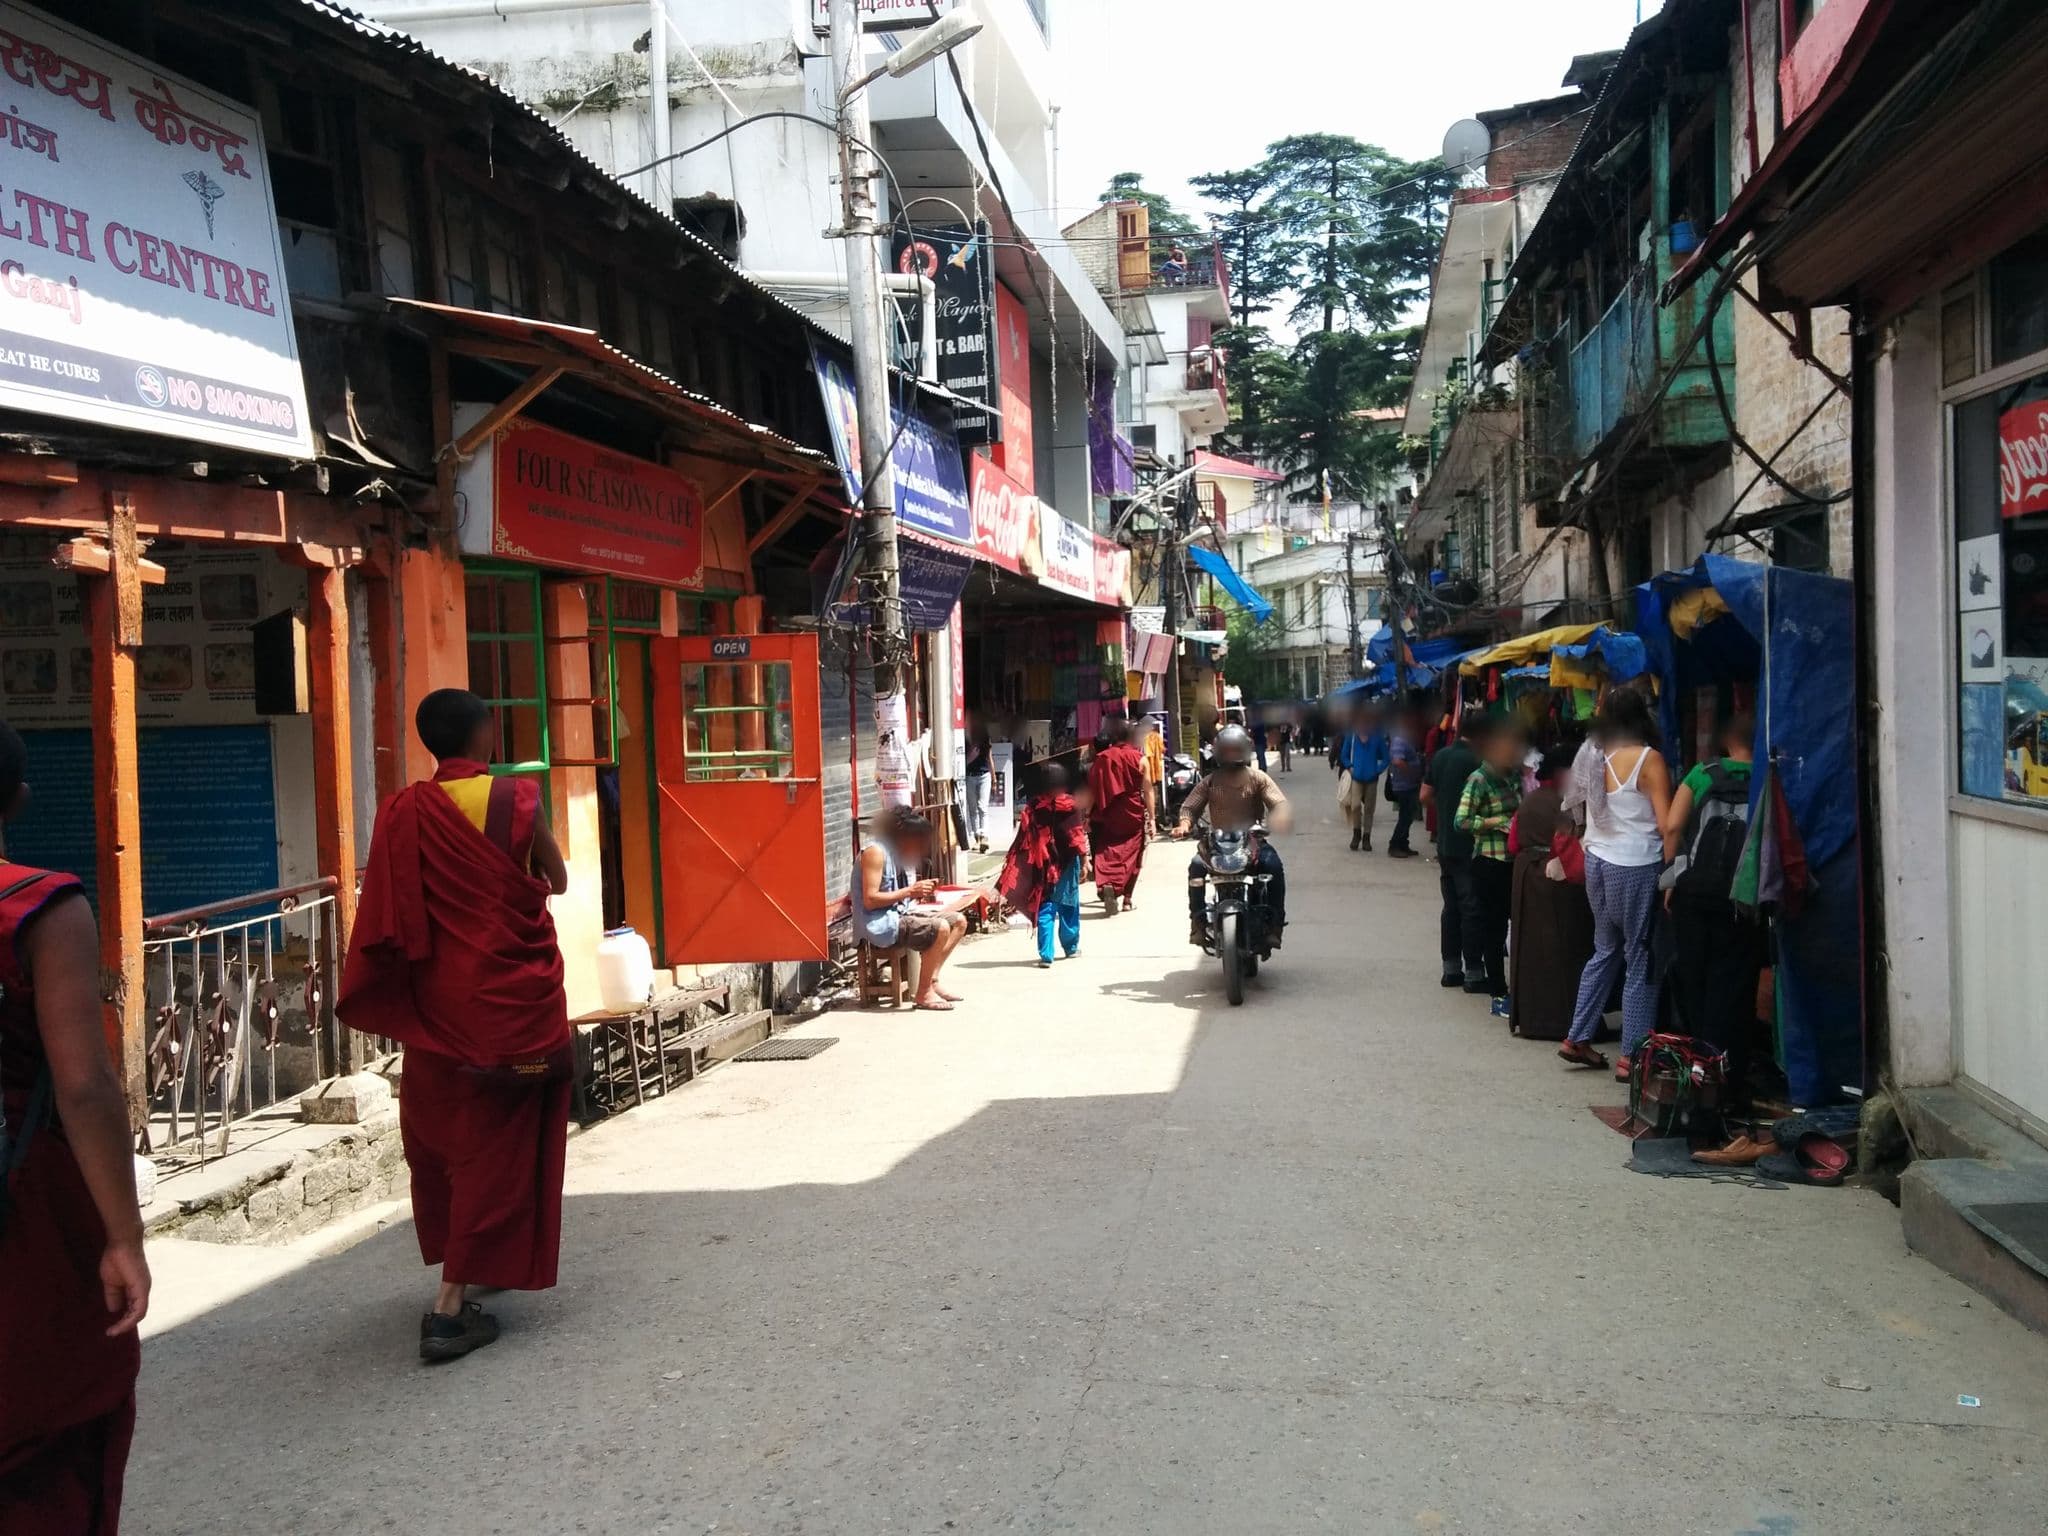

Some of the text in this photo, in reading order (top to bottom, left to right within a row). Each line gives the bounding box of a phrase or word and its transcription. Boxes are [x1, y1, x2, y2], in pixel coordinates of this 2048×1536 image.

[128, 77, 251, 179] केन्द्र
[1, 259, 82, 325] Ganj
[104, 221, 275, 317] CENTRE
[29, 354, 52, 373] HE
[53, 359, 101, 383] CURES
[958, 334, 984, 353] BAR
[167, 377, 294, 430] NO SMOKING
[515, 447, 571, 496] FOUR
[576, 465, 652, 516] SEASONS
[654, 488, 694, 529] CAFE
[714, 642, 746, 655] OPEN
